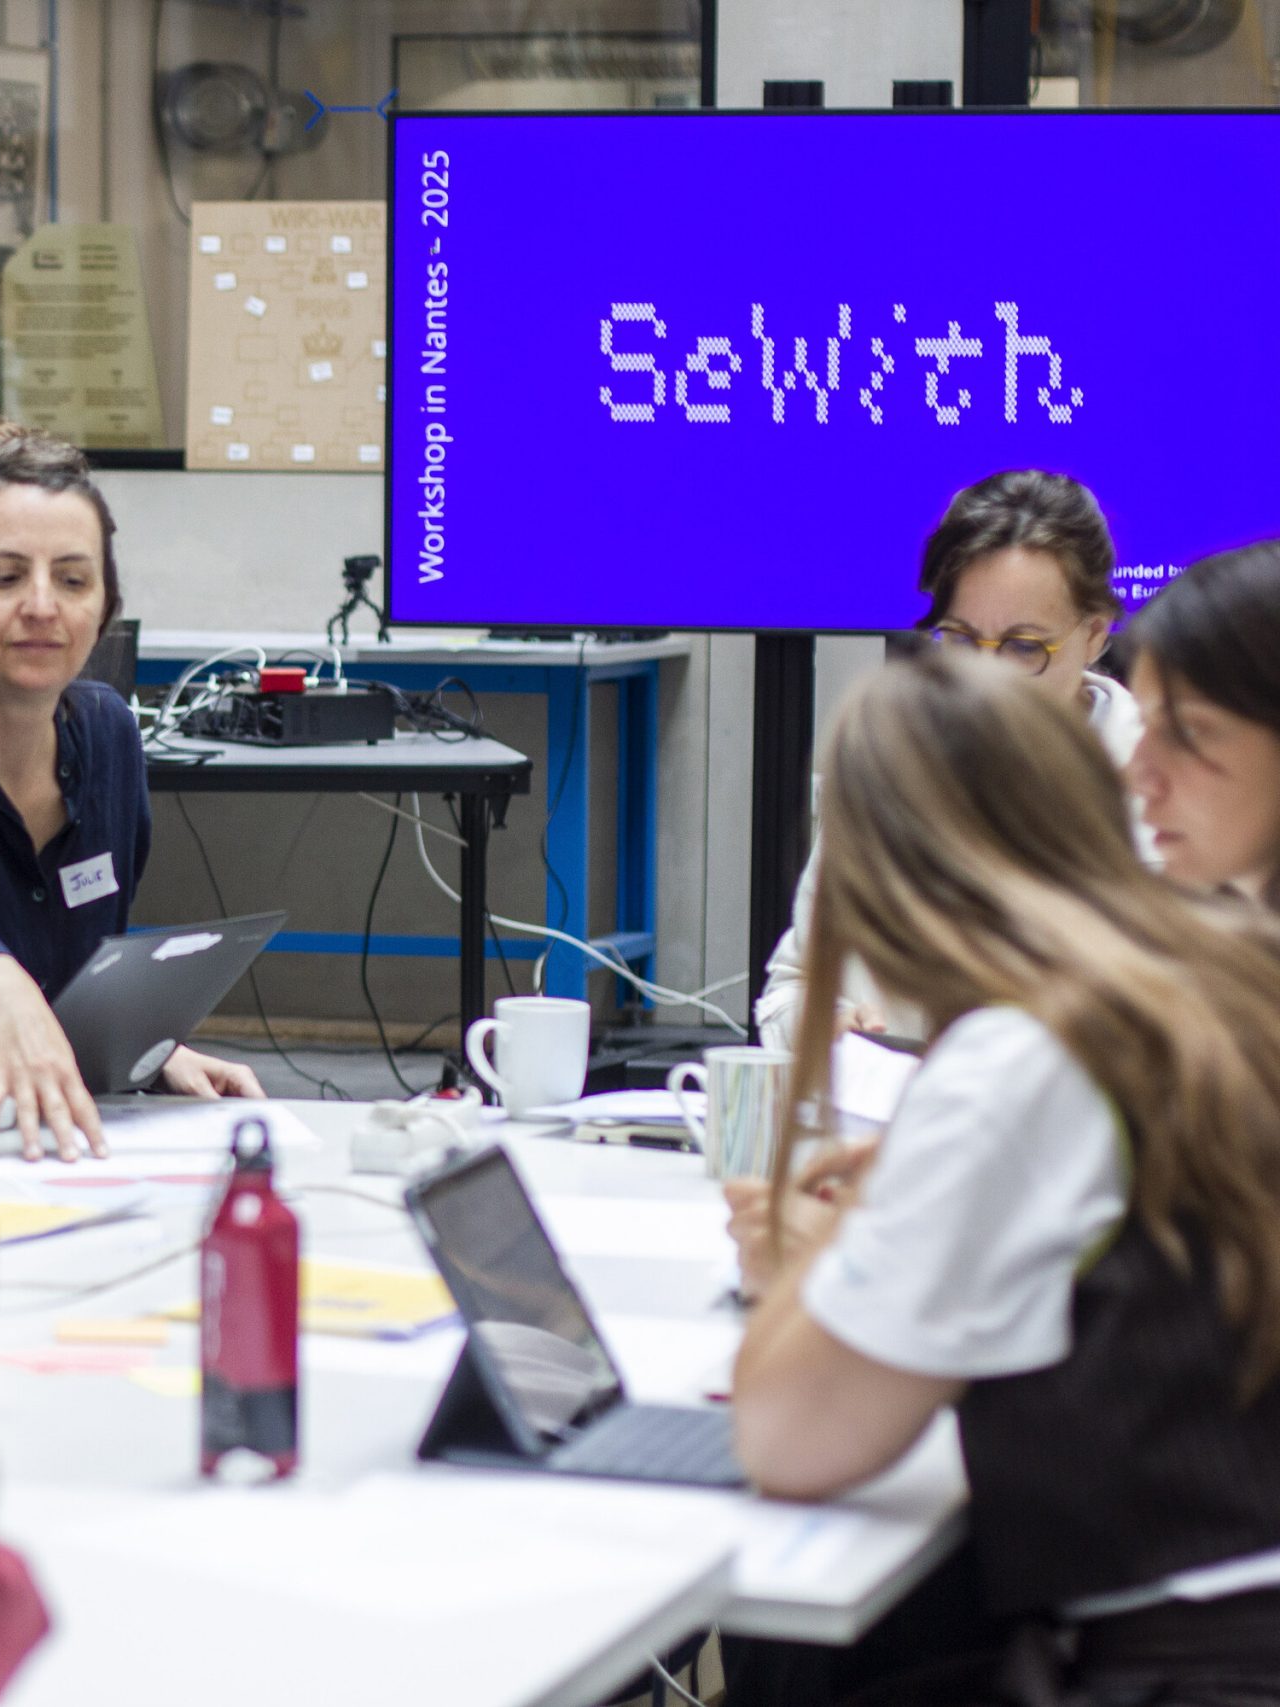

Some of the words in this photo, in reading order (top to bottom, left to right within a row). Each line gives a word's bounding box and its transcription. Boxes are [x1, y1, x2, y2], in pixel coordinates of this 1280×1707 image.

[421, 150, 450, 227] 2025
[420, 262, 449, 374] Nantes
[600, 301, 1083, 425] SeWith
[420, 385, 447, 413] in
[418, 422, 454, 584] Workshop
[1113, 563, 1164, 579] unded
